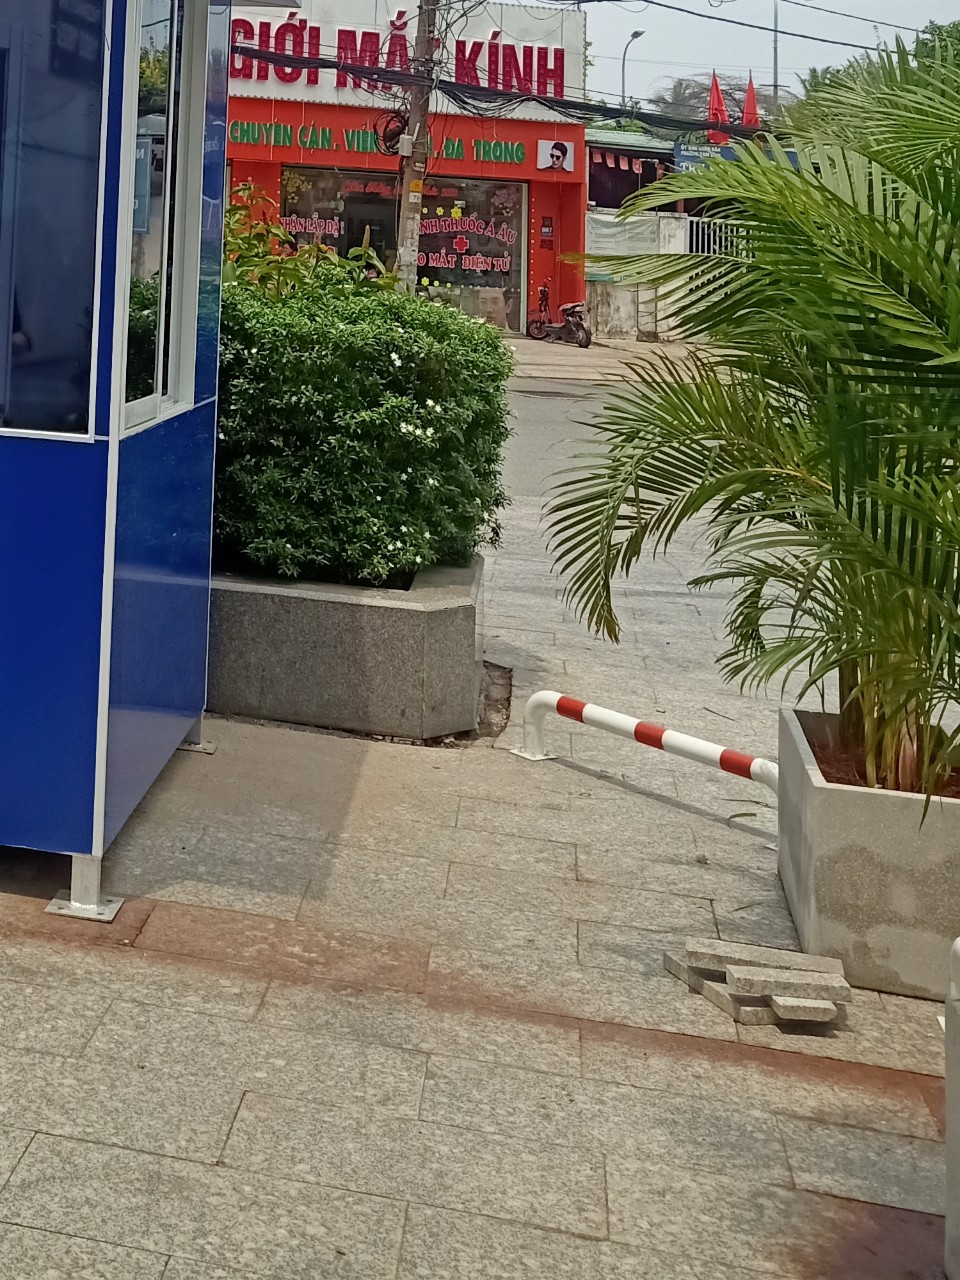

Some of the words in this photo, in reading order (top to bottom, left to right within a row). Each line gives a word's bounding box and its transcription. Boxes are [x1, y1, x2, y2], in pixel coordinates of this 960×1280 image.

[230, 11, 321, 85] GIỚI
[336, 10, 440, 92] MẮ
[454, 30, 566, 99] KÍNH
[306, 211, 326, 233] LẮP
[440, 211, 486, 235] THUỐC
[484, 217, 496, 238] Á
[496, 222, 518, 245] ÂU
[428, 246, 457, 268] MẮT
[461, 252, 493, 273] ĐIỆN
[493, 250, 512, 272] TỬ
